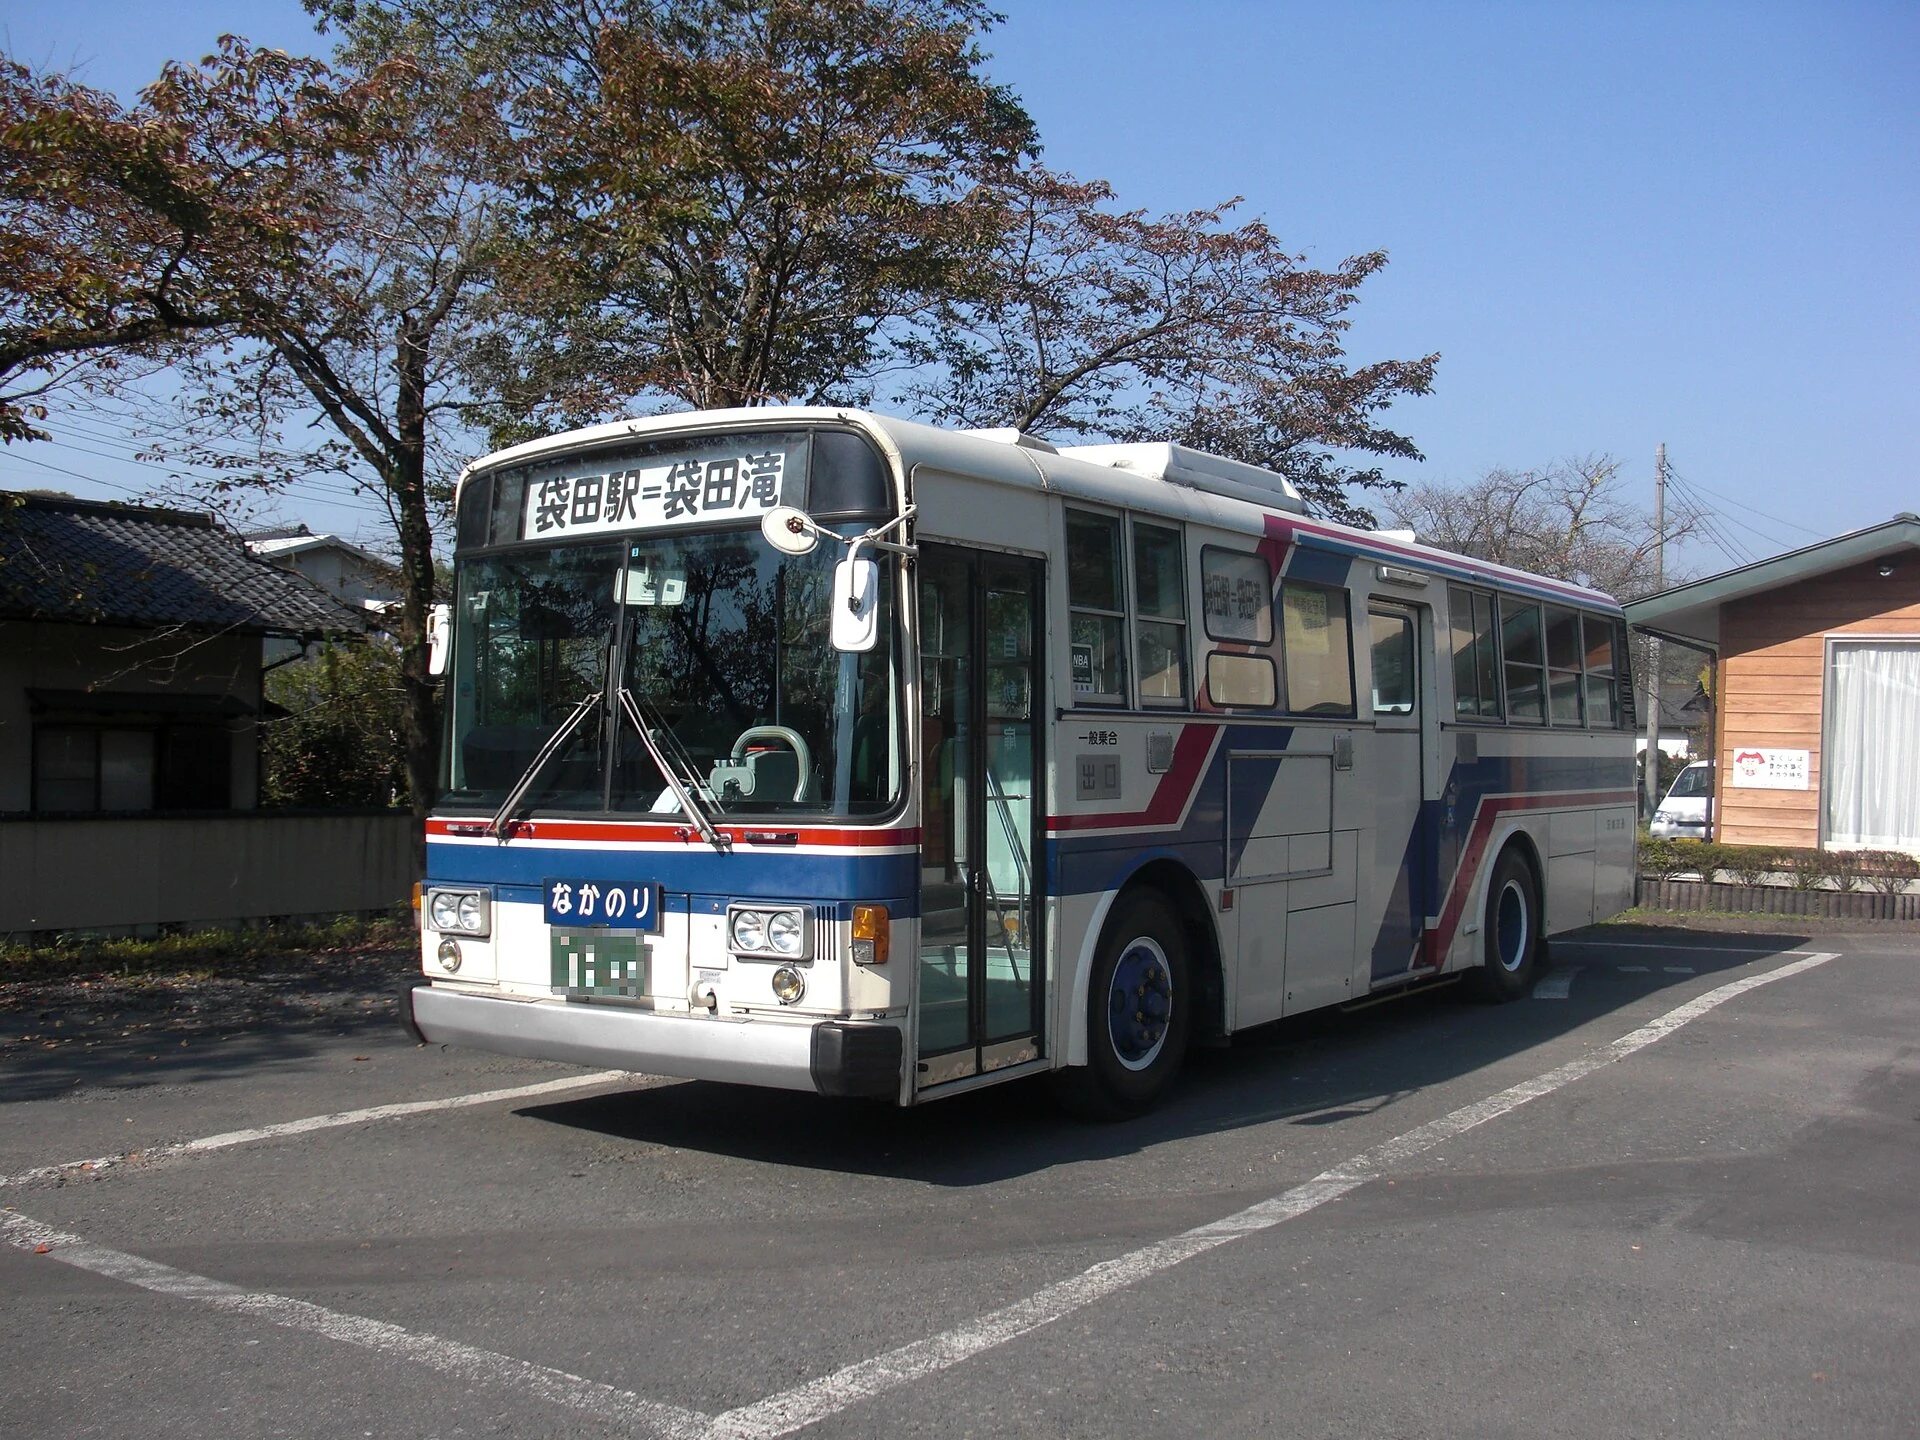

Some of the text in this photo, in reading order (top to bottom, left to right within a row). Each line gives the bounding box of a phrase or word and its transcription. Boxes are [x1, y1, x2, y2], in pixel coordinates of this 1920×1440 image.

[1073, 654, 1089, 667] NBA
[1078, 730, 1118, 746] 一般乗合
[1082, 763, 1117, 790] 出口
[551, 882, 649, 919] なかのり
